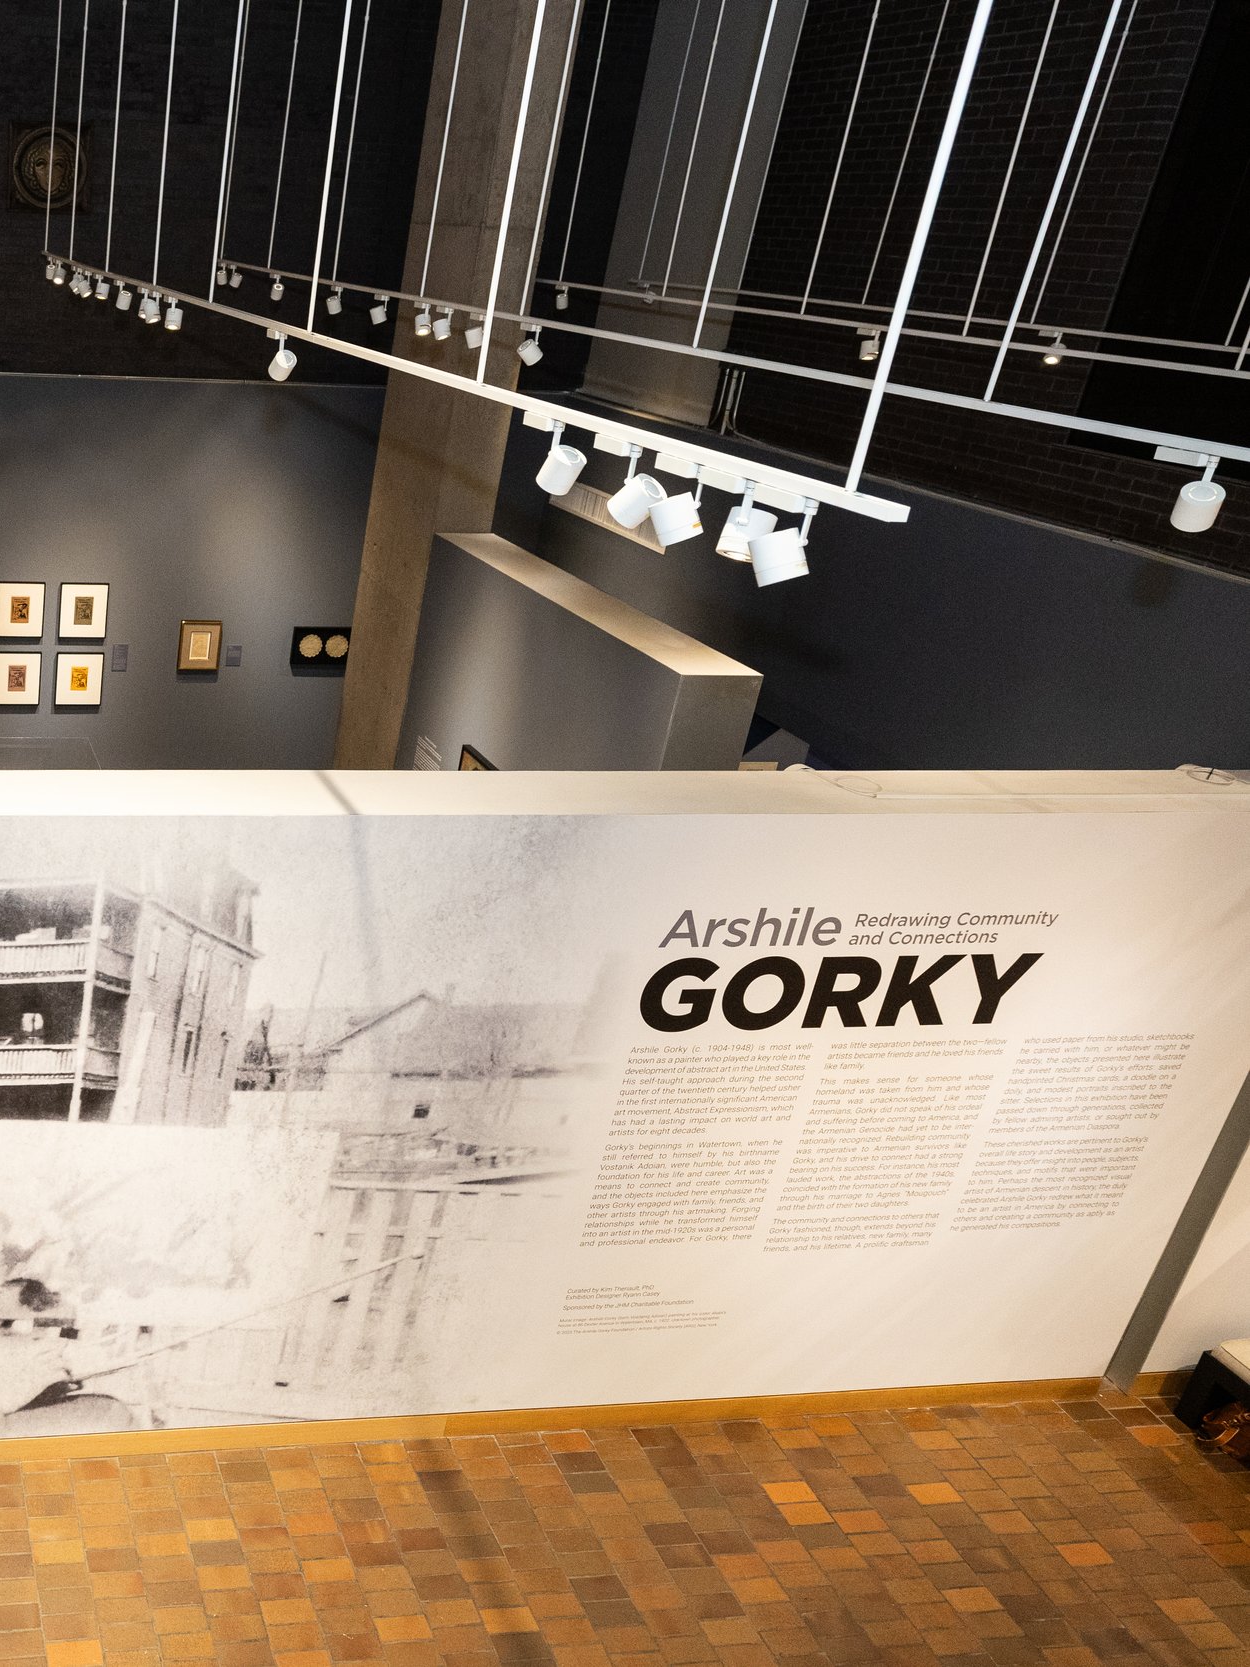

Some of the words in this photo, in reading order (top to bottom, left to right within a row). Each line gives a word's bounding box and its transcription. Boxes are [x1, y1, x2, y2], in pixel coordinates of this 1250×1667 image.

[854, 912, 951, 929] Redrawing
[957, 910, 1059, 929] Community
[658, 907, 842, 948] Arshile
[849, 931, 882, 946] and
[888, 929, 998, 945] Connections
[639, 952, 1045, 1033] GORKY
[663, 1046, 688, 1055] Gorky
[673, 1056, 703, 1065] painter
[722, 1055, 750, 1064] played
[756, 1055, 772, 1063] key
[686, 1077, 726, 1086] approach
[728, 1076, 755, 1085] during
[618, 1089, 649, 1098] quarter
[716, 1086, 748, 1095] century
[748, 1086, 777, 1094] helped
[658, 1118, 686, 1127] lasting
[689, 1117, 718, 1126] impact
[649, 1128, 671, 1137] eight
